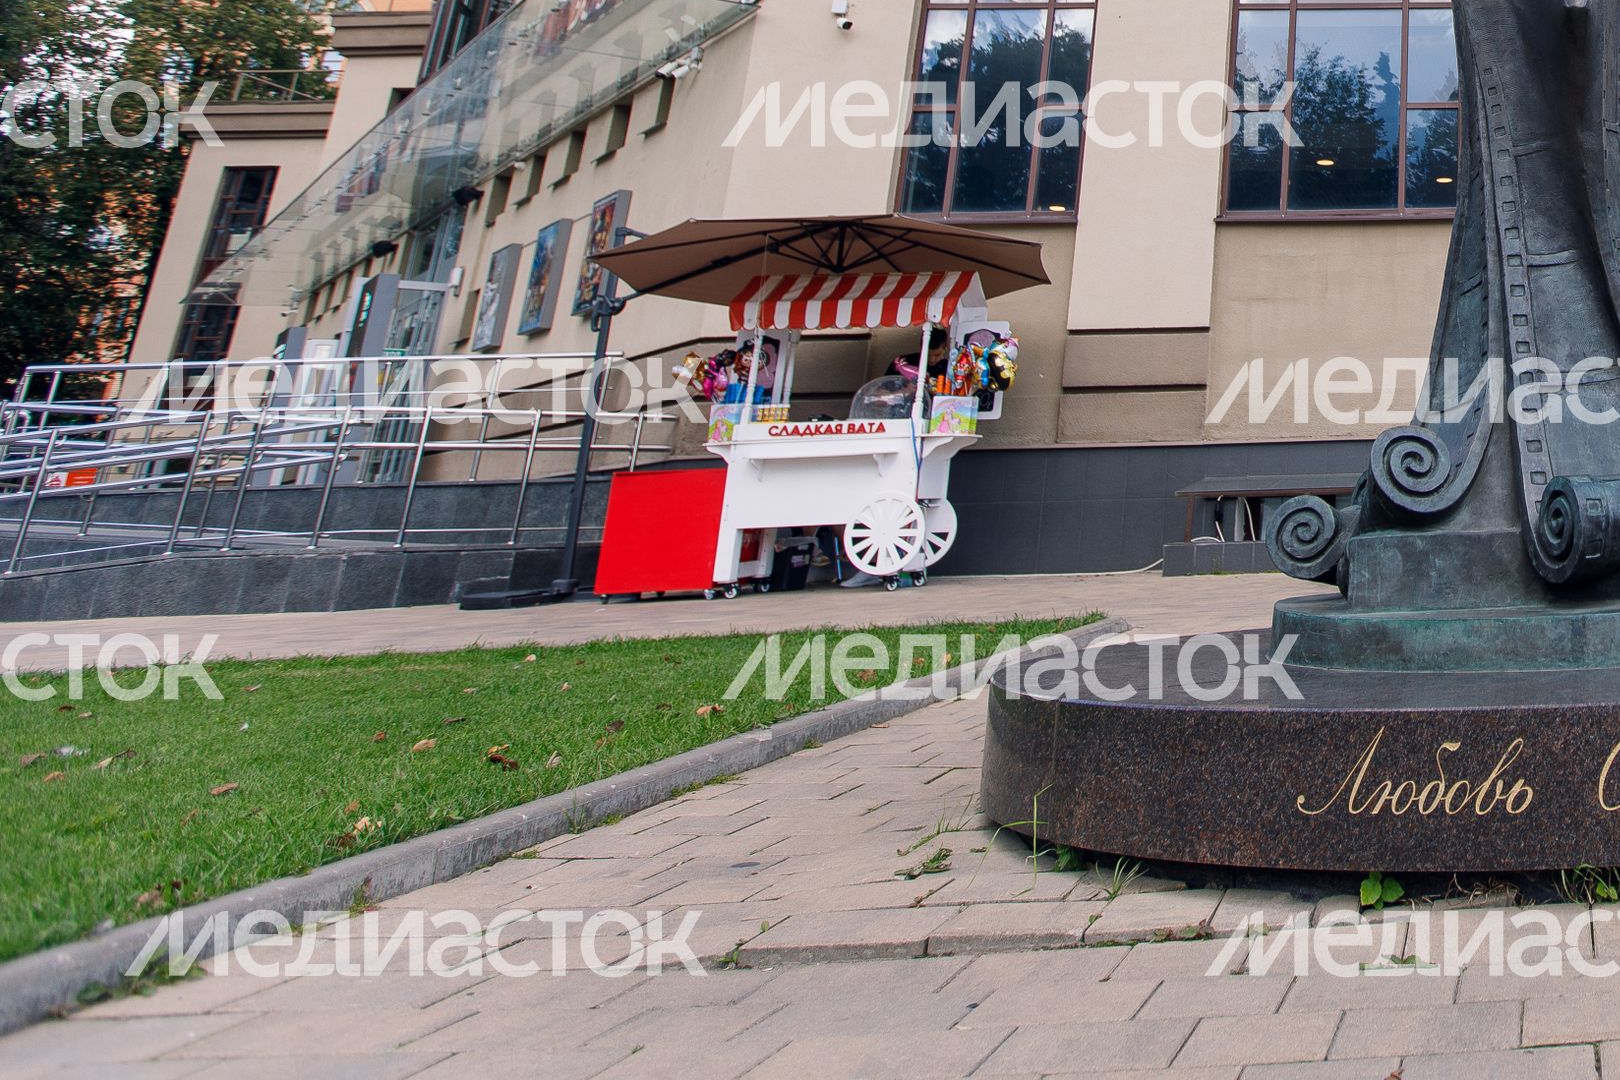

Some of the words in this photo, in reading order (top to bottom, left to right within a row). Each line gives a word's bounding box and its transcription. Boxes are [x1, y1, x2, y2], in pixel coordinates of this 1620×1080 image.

[768, 423, 843, 437] СЛАДКАЯ
[847, 421, 886, 434] ВАТА
[1296, 725, 1533, 817] Любовь
